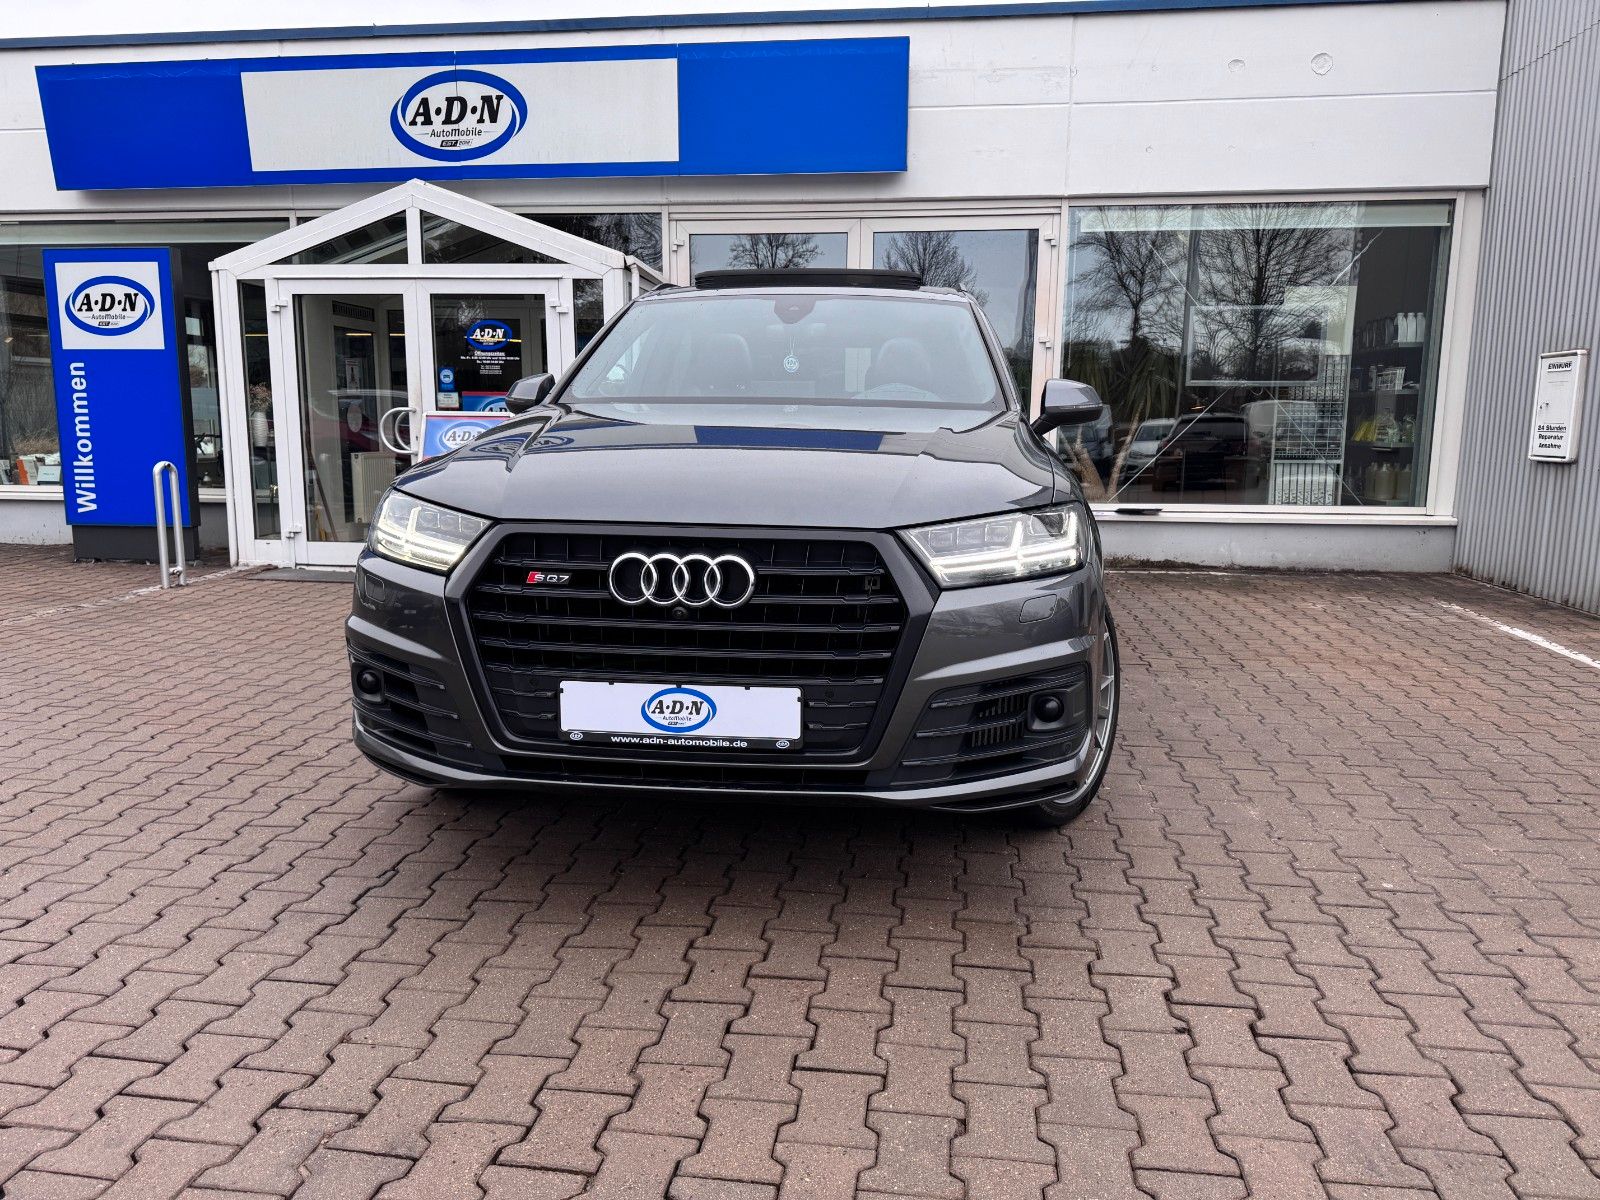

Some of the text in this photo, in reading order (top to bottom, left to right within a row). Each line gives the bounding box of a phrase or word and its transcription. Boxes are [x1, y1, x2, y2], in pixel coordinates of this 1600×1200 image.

[430, 127, 483, 138] AutoMobile
[1547, 361, 1572, 370] EINWURF
[69, 362, 97, 513] Willkommen
[1538, 433, 1564, 441] Reparatur
[532, 573, 570, 583] SQ7
[610, 735, 748, 748] www.adn-automobile.de
